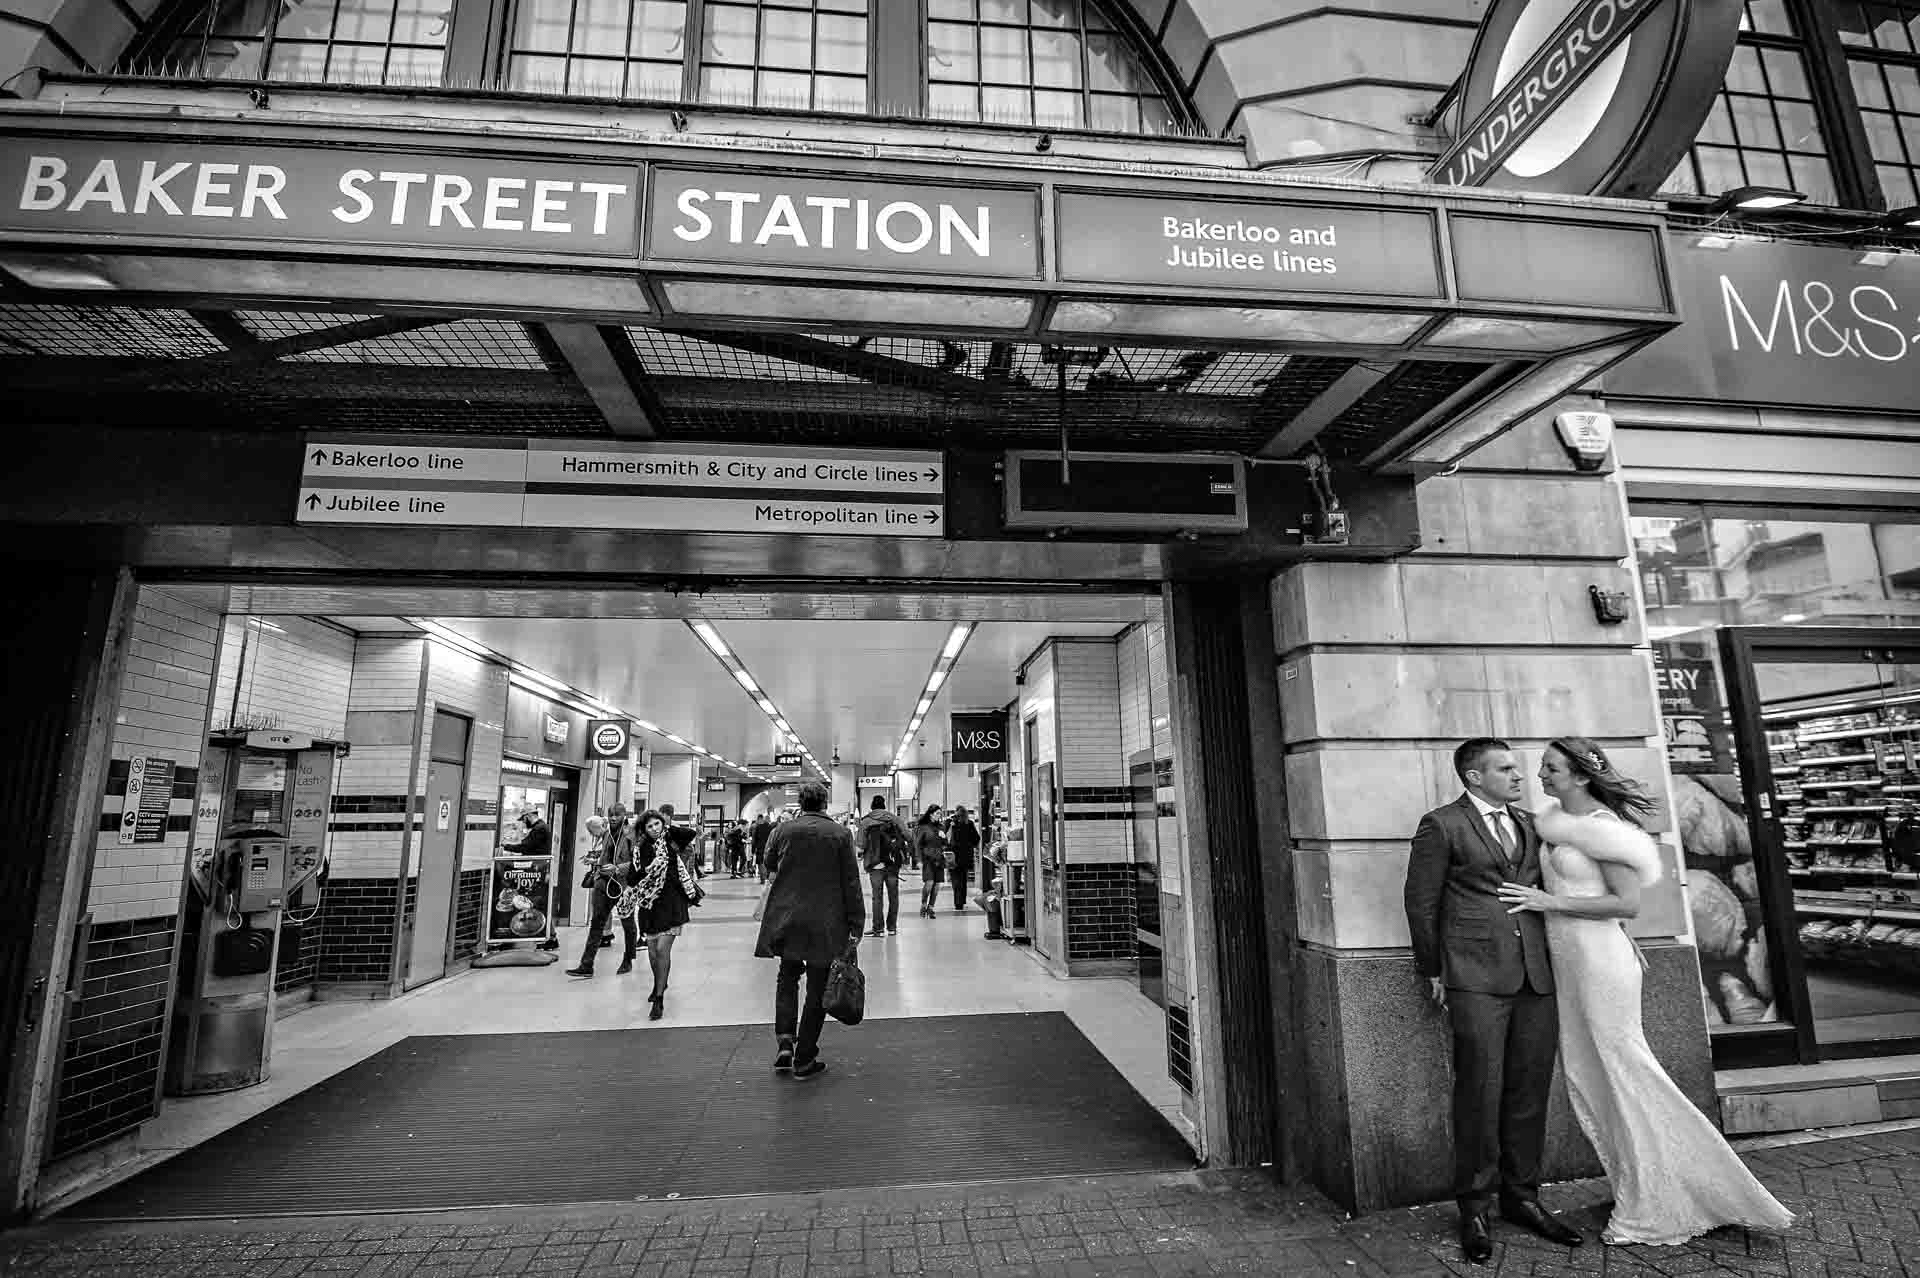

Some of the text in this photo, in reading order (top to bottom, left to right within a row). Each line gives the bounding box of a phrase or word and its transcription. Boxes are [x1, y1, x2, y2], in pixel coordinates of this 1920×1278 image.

[19, 155, 991, 257] BAKER STREET STATION
[1163, 216, 1337, 246] Bakerloo and
[1167, 245, 1337, 274] Jubilee lines
[1719, 274, 1908, 362] M&S
[331, 451, 464, 470] Bakerloo line
[561, 456, 918, 483] Hammersmith & City and Circle lines
[326, 495, 446, 513] Jubilee line
[754, 504, 919, 526] Metropolitan line
[957, 730, 1001, 750] M&S
